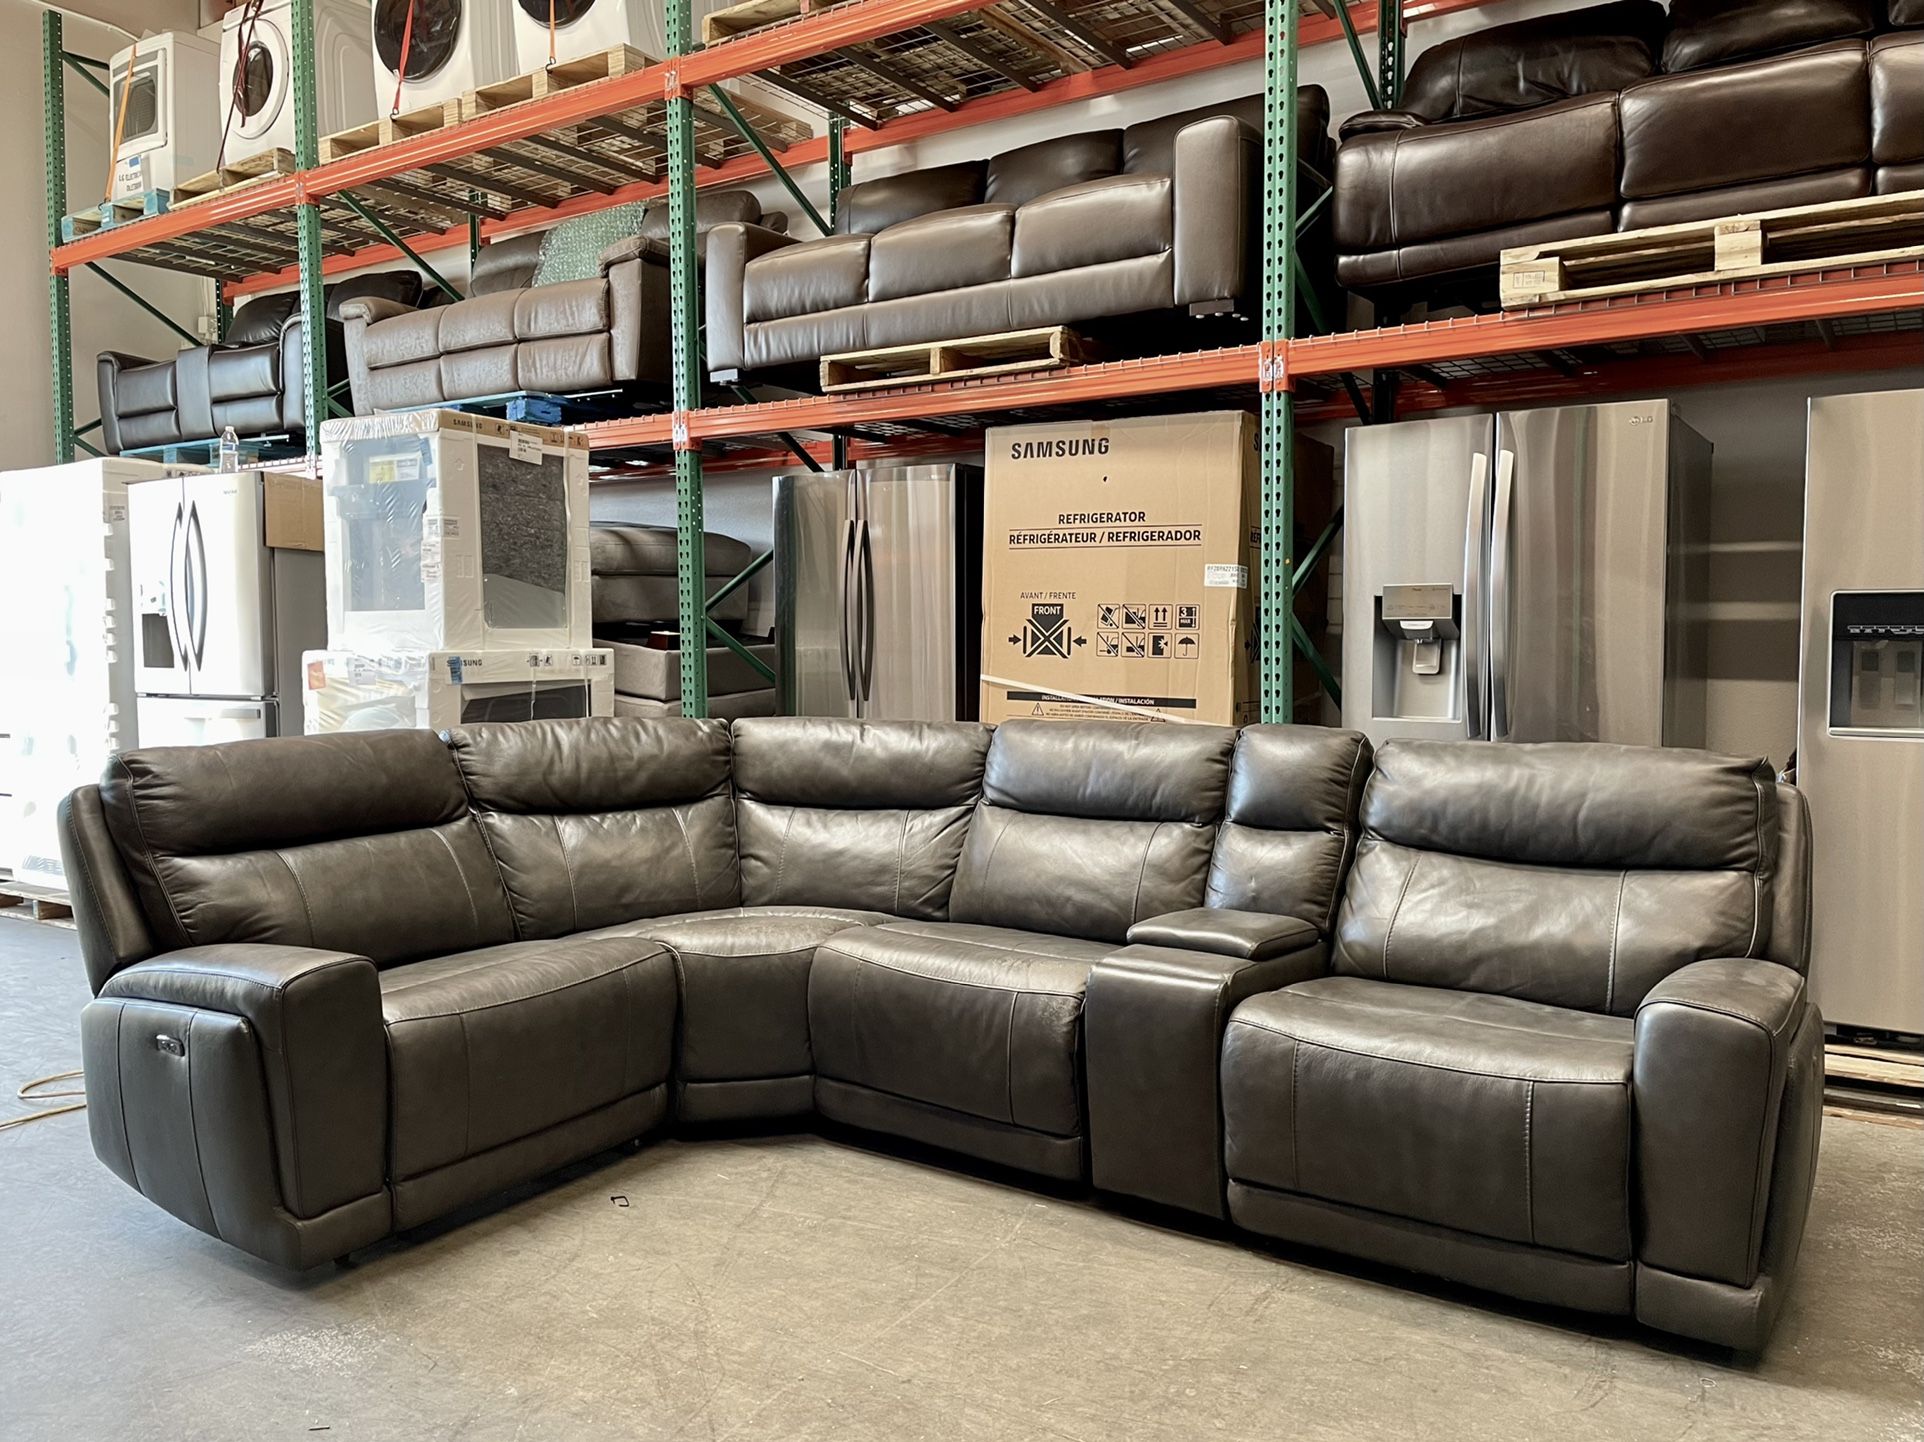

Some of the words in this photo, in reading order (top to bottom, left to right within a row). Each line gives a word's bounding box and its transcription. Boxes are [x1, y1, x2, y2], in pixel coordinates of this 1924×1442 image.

[1011, 437, 1110, 460] SAMSUNG
[1058, 511, 1146, 525] REFRIGERATOR
[1009, 530, 1097, 545] RÉFRIGÉRATEUR
[1107, 529, 1201, 543] REFRIGERADOR
[1020, 591, 1043, 600] AVANT
[1049, 591, 1077, 600] FRENTE
[1033, 605, 1062, 615] FRONT
[1180, 607, 1188, 617] 3
[446, 658, 483, 667] SSUNG
